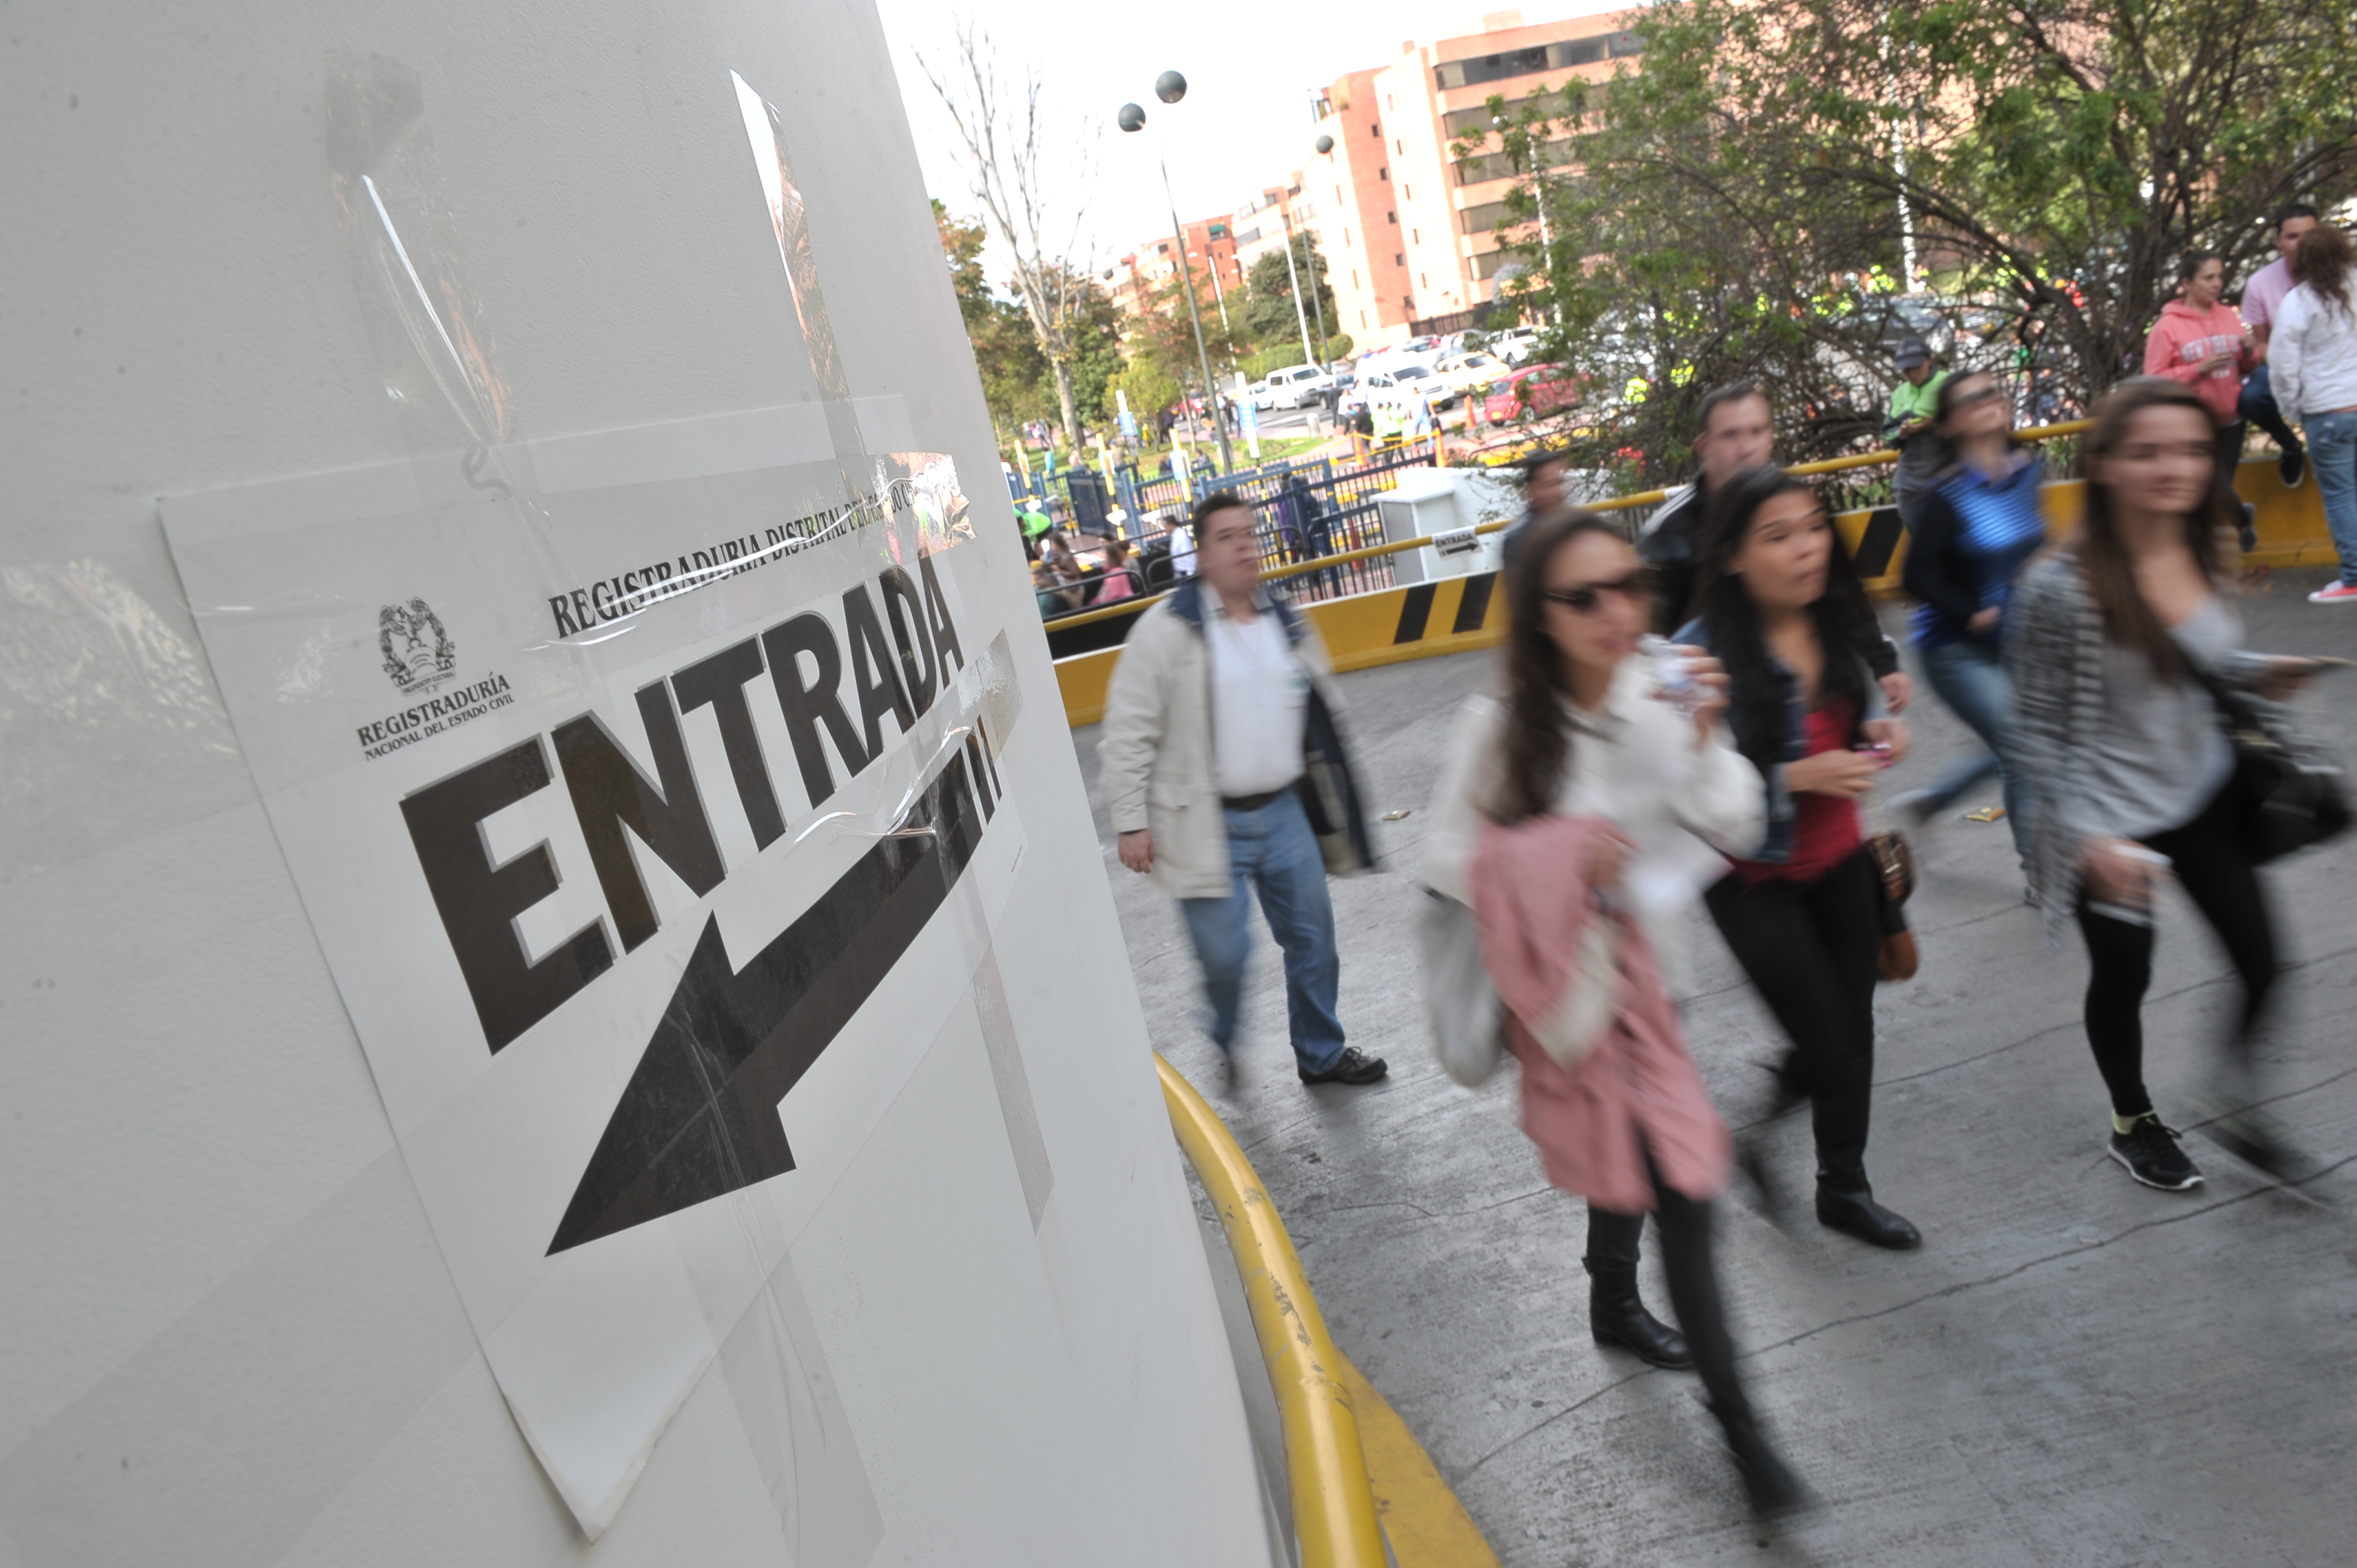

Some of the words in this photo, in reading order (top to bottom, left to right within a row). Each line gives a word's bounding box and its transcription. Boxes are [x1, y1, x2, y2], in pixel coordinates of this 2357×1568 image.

[548, 534, 768, 639] REGISTRADURIA
[765, 506, 847, 561] DISTRITAL
[1435, 533, 1474, 548] ENTRADA
[357, 671, 511, 747] REGISTRADURÍA
[364, 731, 423, 762] NACIONAL
[424, 720, 448, 738] DEL
[447, 703, 488, 728] ESTADO
[488, 693, 516, 710] CIVIL
[398, 547, 965, 1056] ENTRADA
